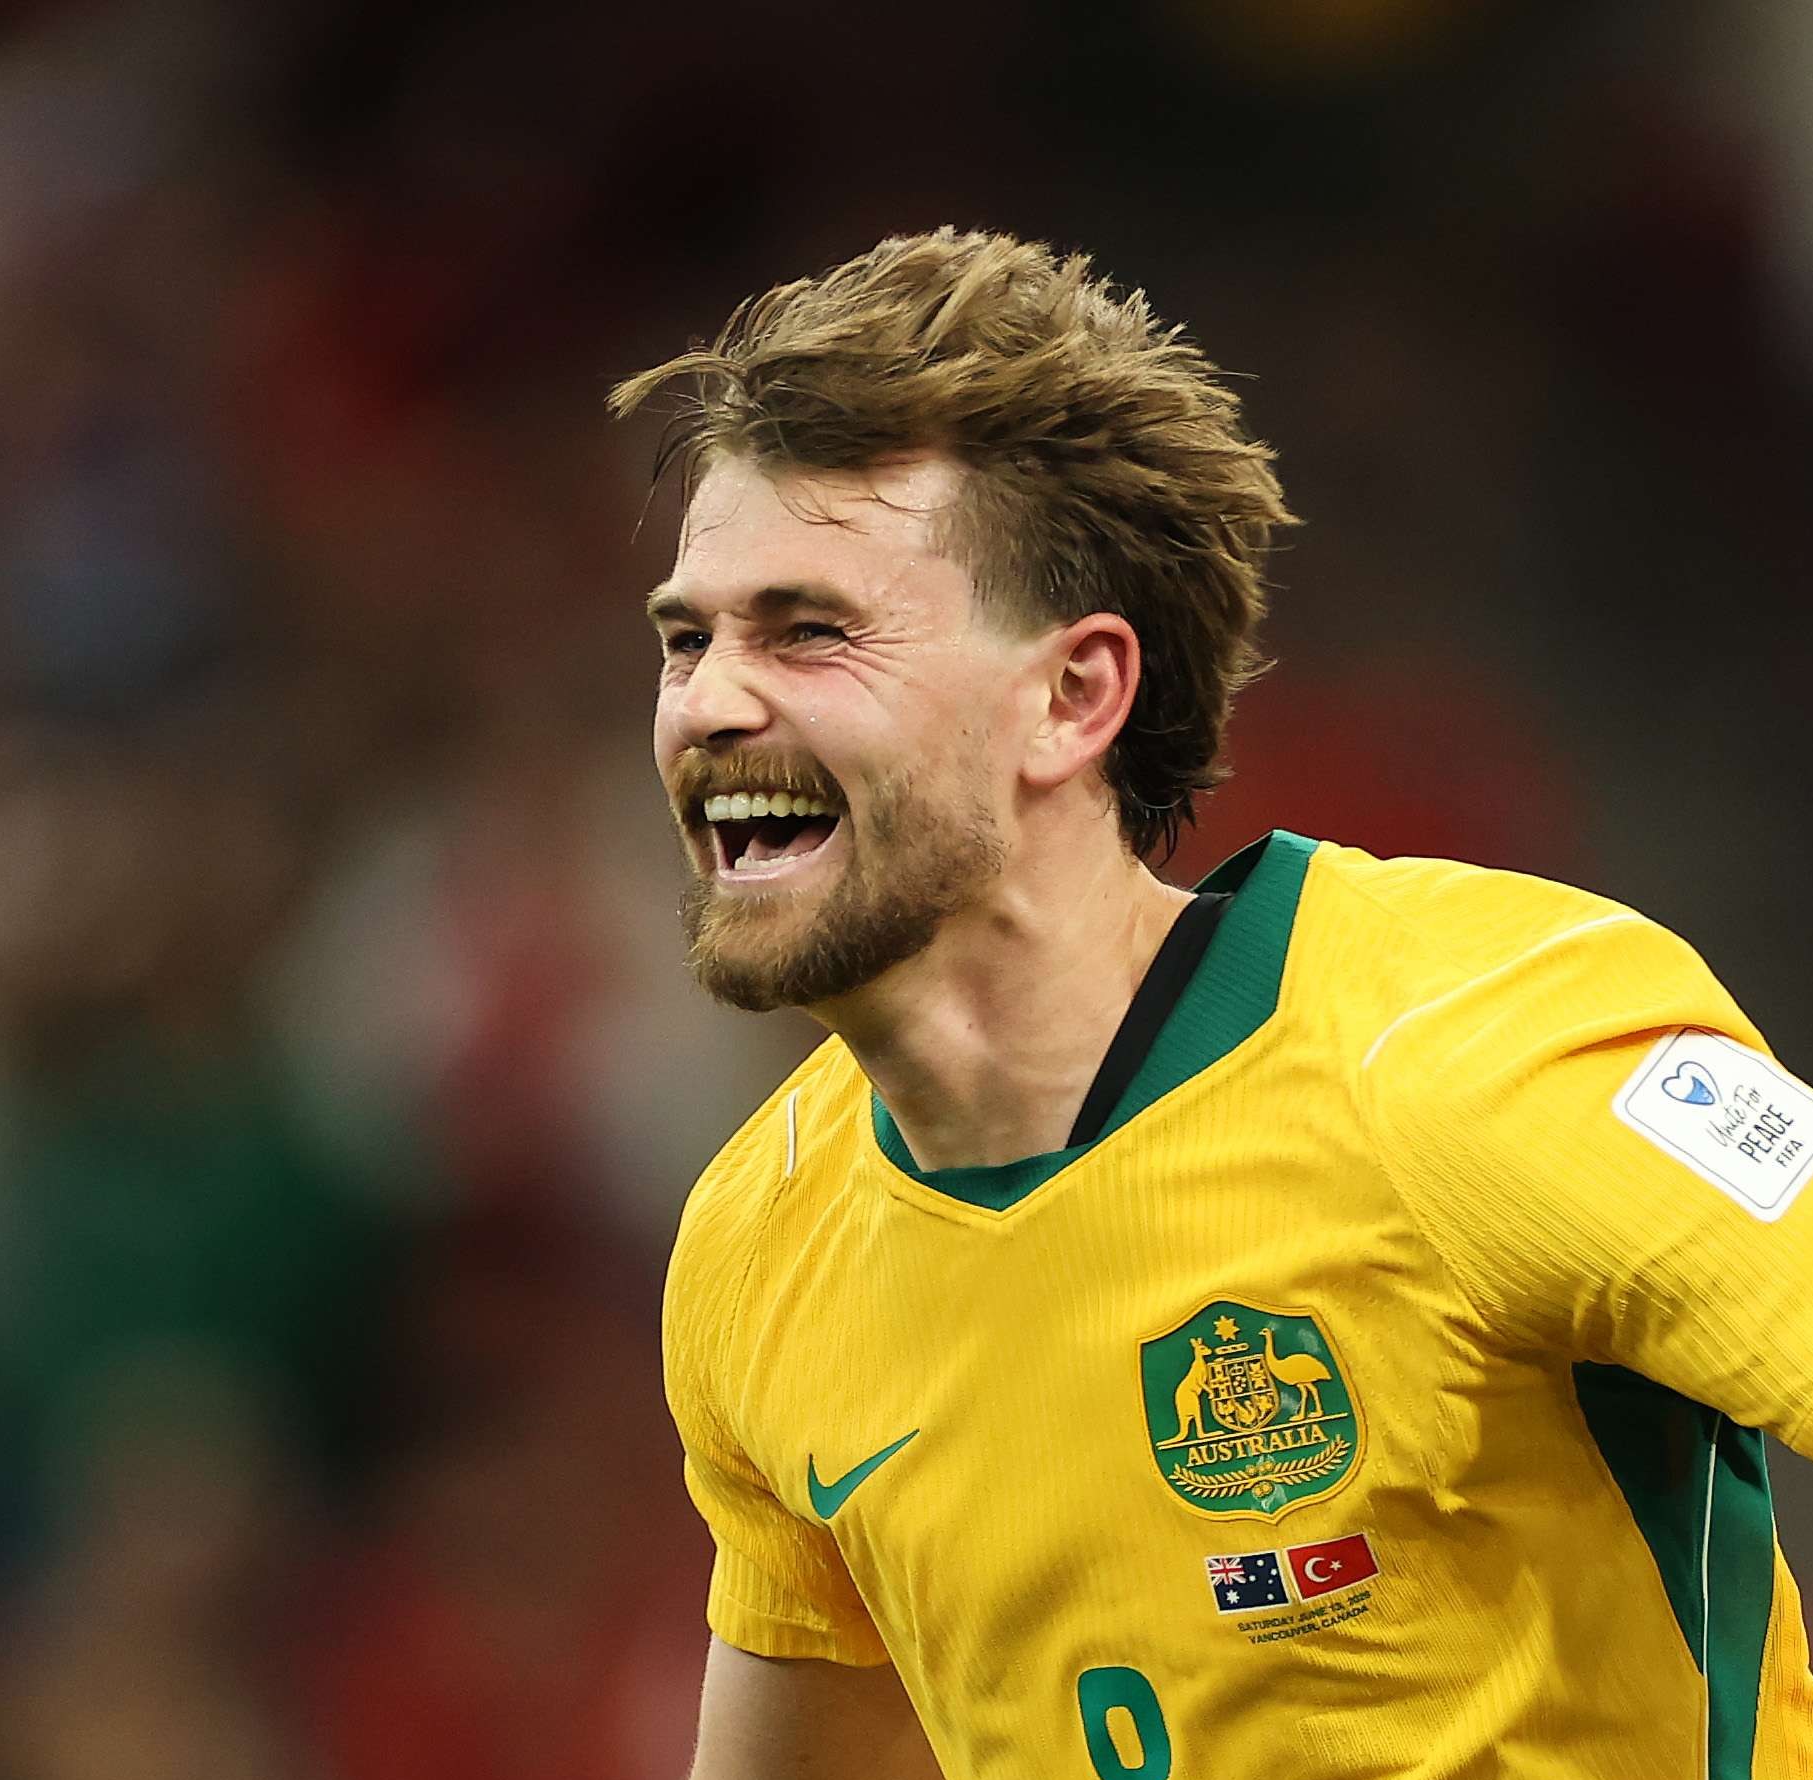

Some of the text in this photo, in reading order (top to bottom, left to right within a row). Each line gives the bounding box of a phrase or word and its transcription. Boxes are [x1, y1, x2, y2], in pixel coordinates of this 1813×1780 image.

[1737, 1104, 1794, 1164] PEACE
[1775, 1139, 1804, 1169] FIFA
[1186, 1423, 1329, 1467] AUSTRALIA
[1237, 1615, 1294, 1632] SATURDAY
[1321, 1604, 1368, 1628] CANADA
